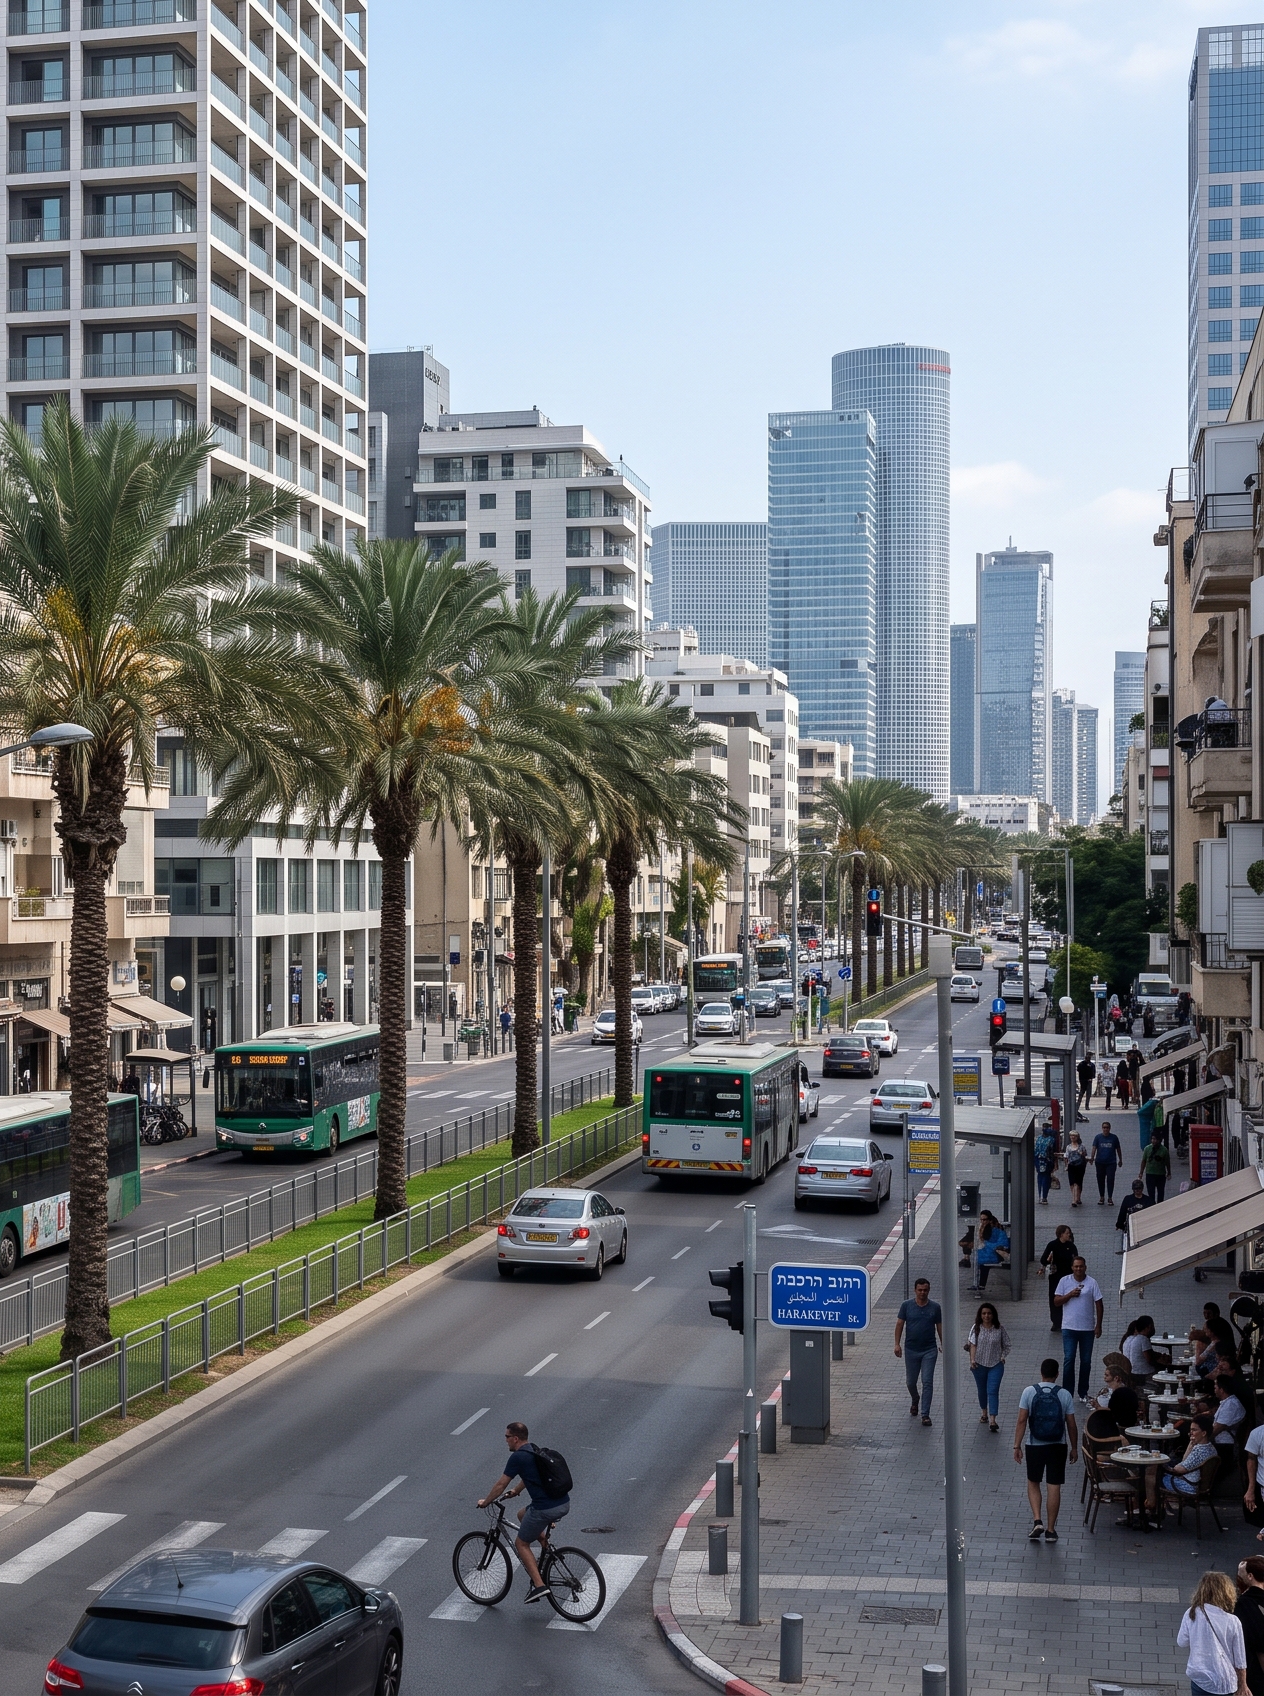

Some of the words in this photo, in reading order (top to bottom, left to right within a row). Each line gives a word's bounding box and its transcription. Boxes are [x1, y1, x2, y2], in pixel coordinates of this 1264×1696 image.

[776, 1274, 823, 1287] הרכבת
[777, 1309, 841, 1321] HARAKEVET
[848, 1314, 859, 1323] St.
